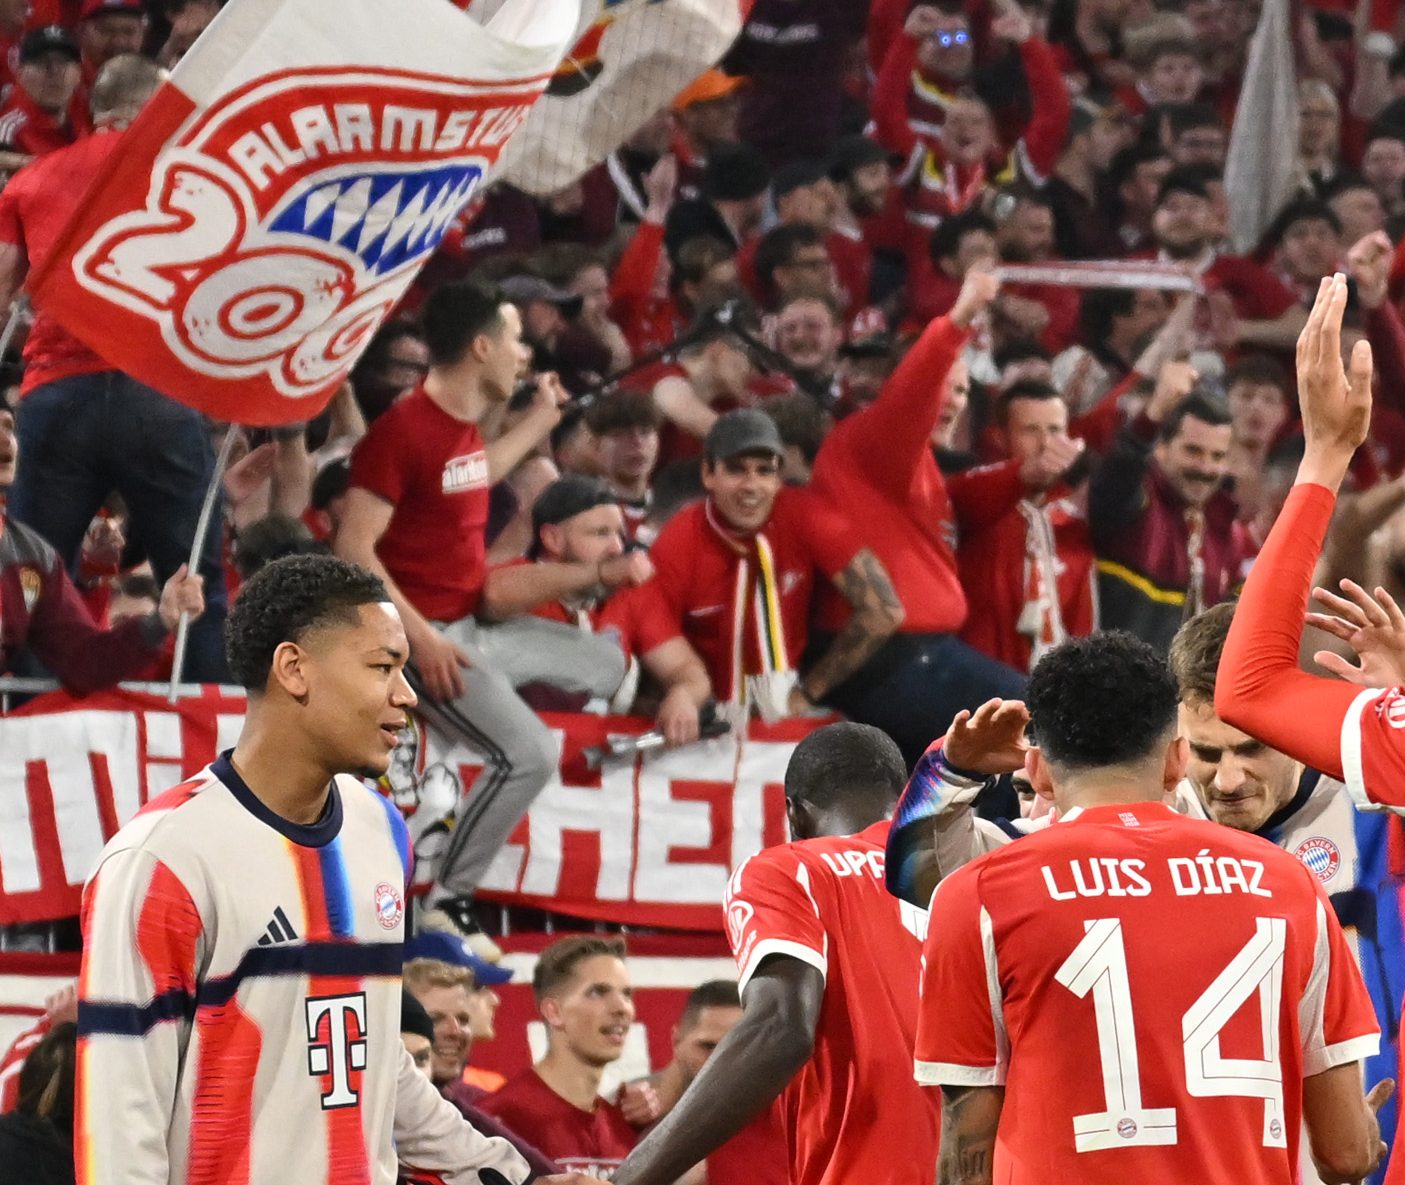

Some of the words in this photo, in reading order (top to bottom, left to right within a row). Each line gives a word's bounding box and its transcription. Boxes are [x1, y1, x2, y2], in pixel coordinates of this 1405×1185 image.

[1041, 857, 1152, 900] LUIS
[1167, 848, 1272, 897] DÍAZ
[1054, 917, 1287, 1153] 14
